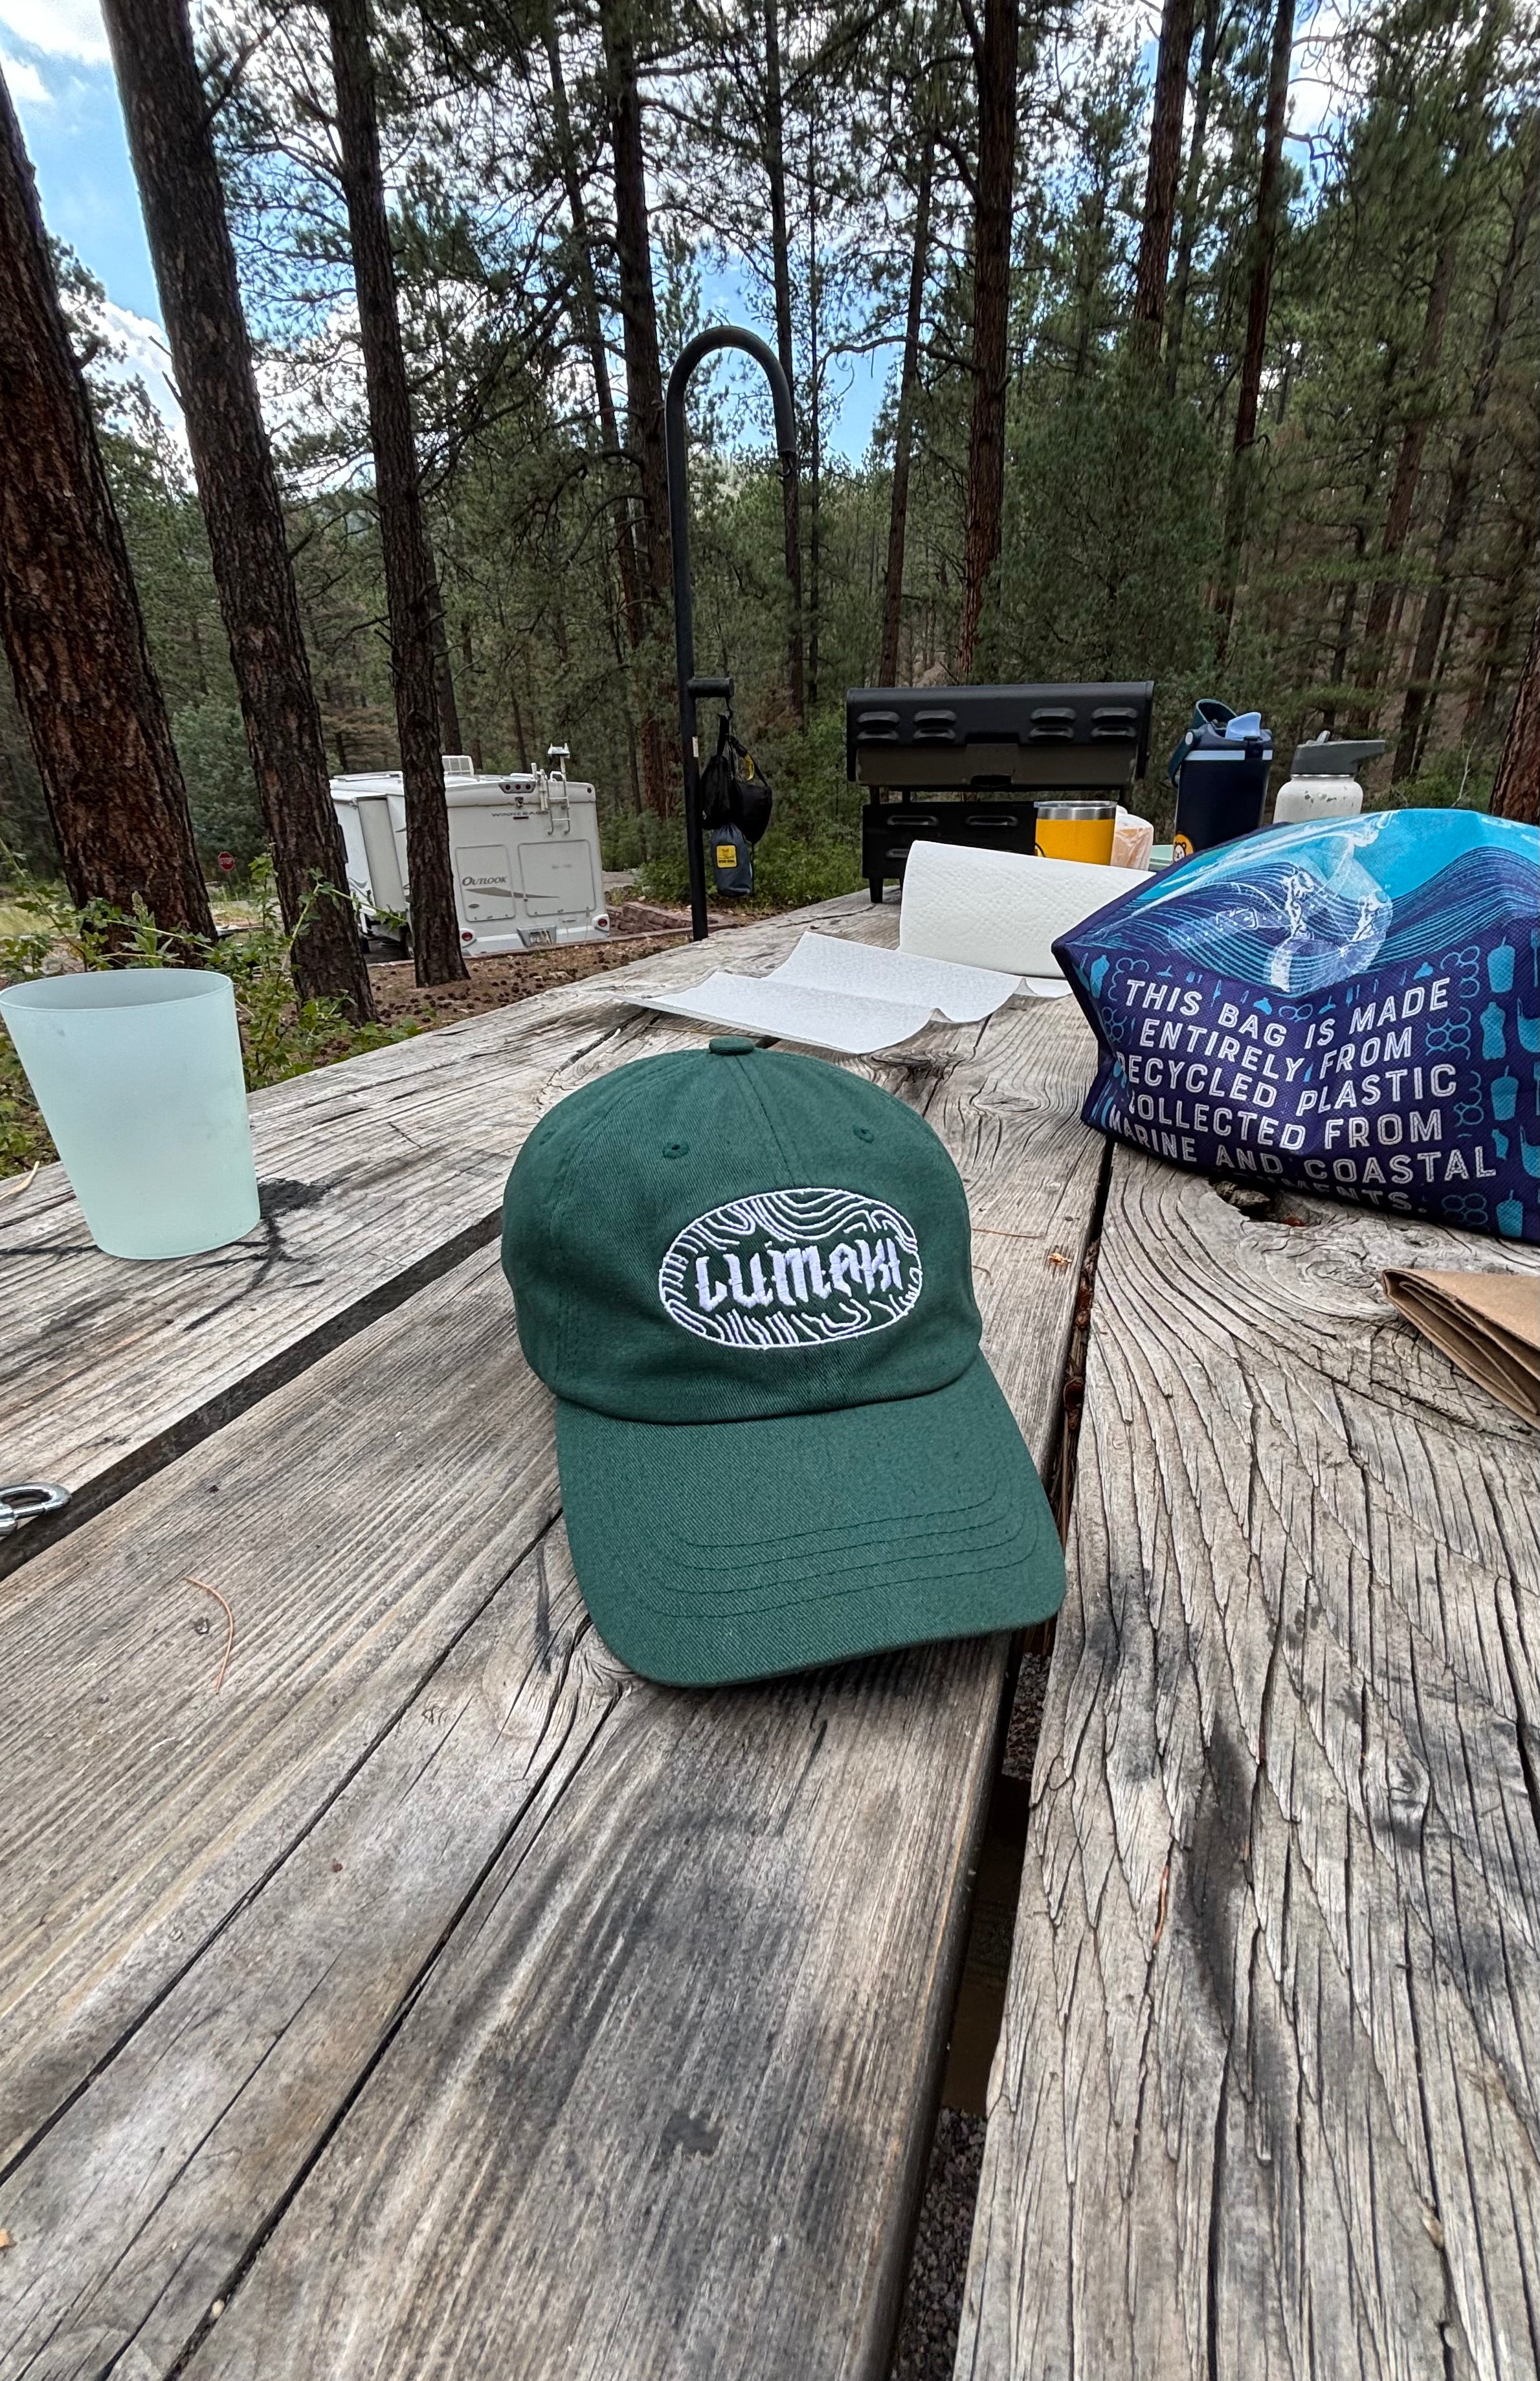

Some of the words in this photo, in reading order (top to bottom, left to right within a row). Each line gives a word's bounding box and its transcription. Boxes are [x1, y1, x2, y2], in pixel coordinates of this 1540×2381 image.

[462, 877, 507, 886] OUTLOOK
[1125, 978, 1203, 1016] THIS
[1218, 1002, 1287, 1047] BAG
[1304, 1018, 1335, 1050] IS
[1348, 977, 1450, 1035] MADE
[1139, 1018, 1305, 1082] ENTIRELY
[1319, 1026, 1412, 1080] FROM
[1295, 1063, 1456, 1117] PLASTIC
[1108, 1104, 1197, 1163] MARINE
[1215, 1144, 1284, 1174] AND
[1303, 1146, 1497, 1185] COASTAL
[1324, 1108, 1442, 1150] FROM
